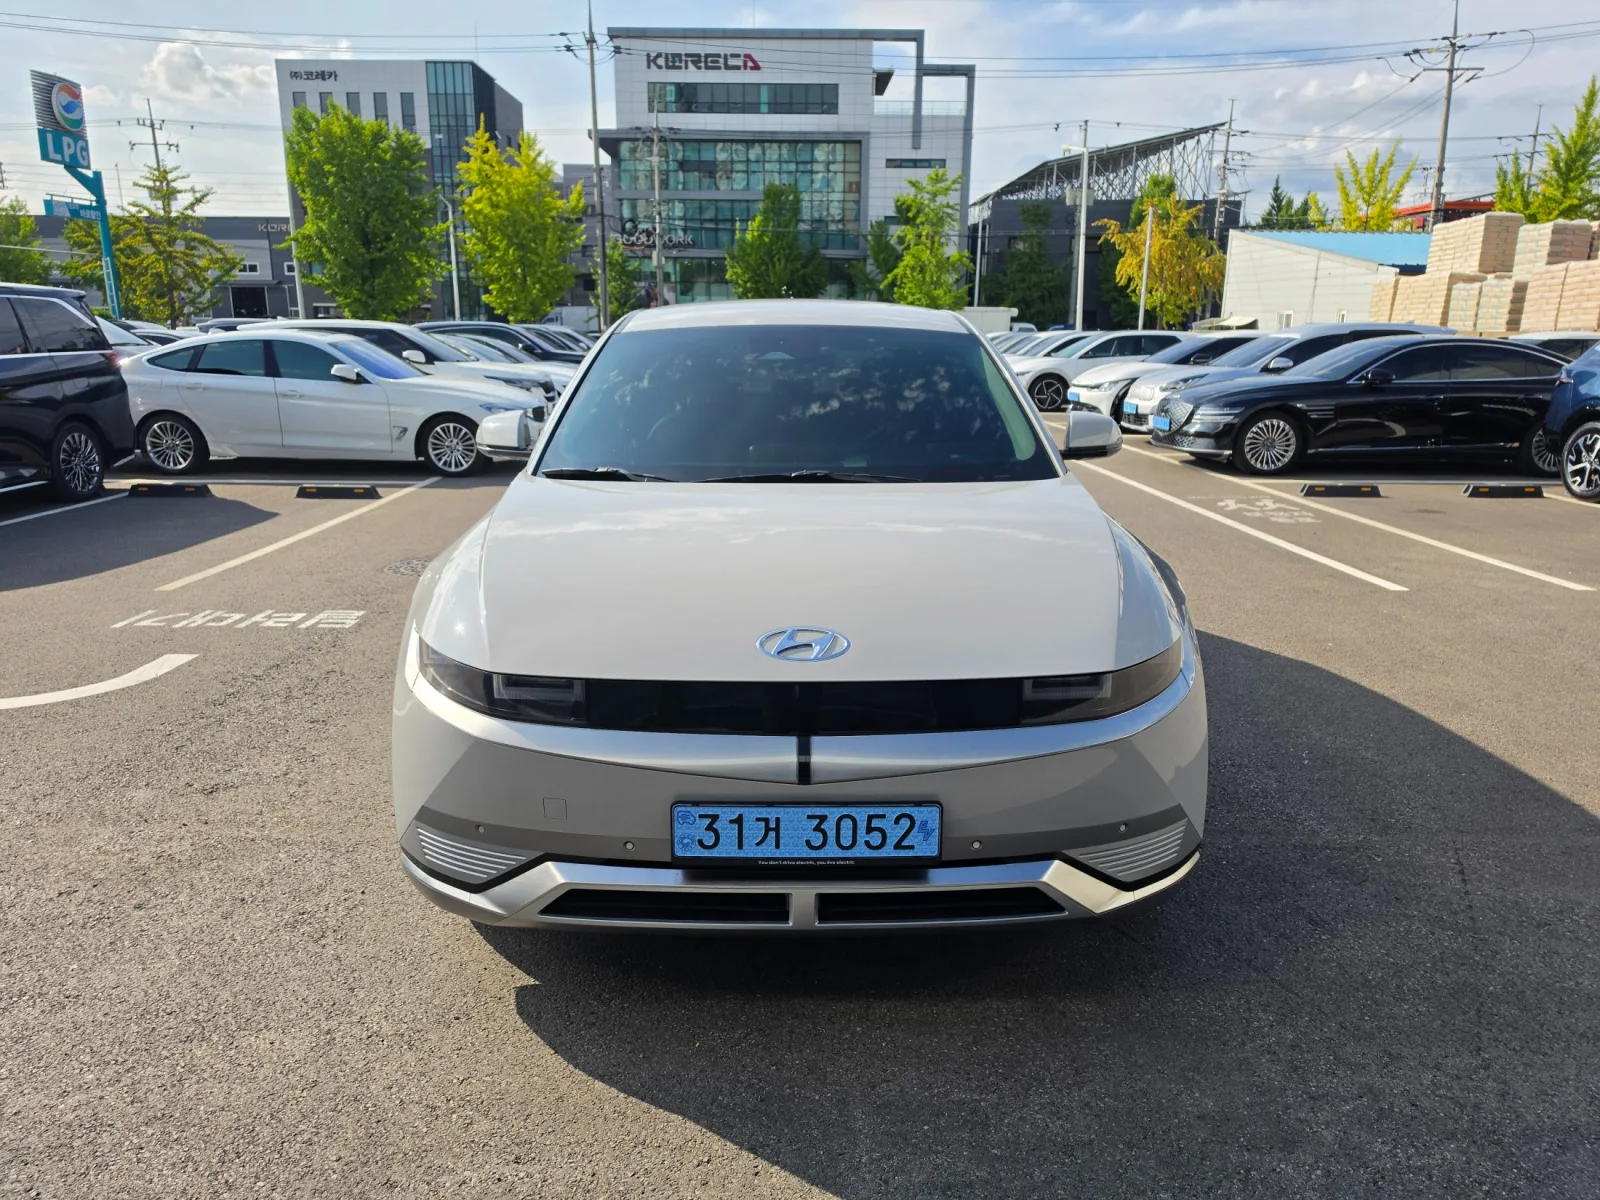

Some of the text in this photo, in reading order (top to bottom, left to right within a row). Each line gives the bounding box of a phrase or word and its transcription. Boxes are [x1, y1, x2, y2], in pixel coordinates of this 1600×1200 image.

[46, 132, 89, 167] LPG
[258, 223, 291, 232] KOR
[697, 812, 917, 851] 31거 3052
[917, 820, 936, 842] EV
